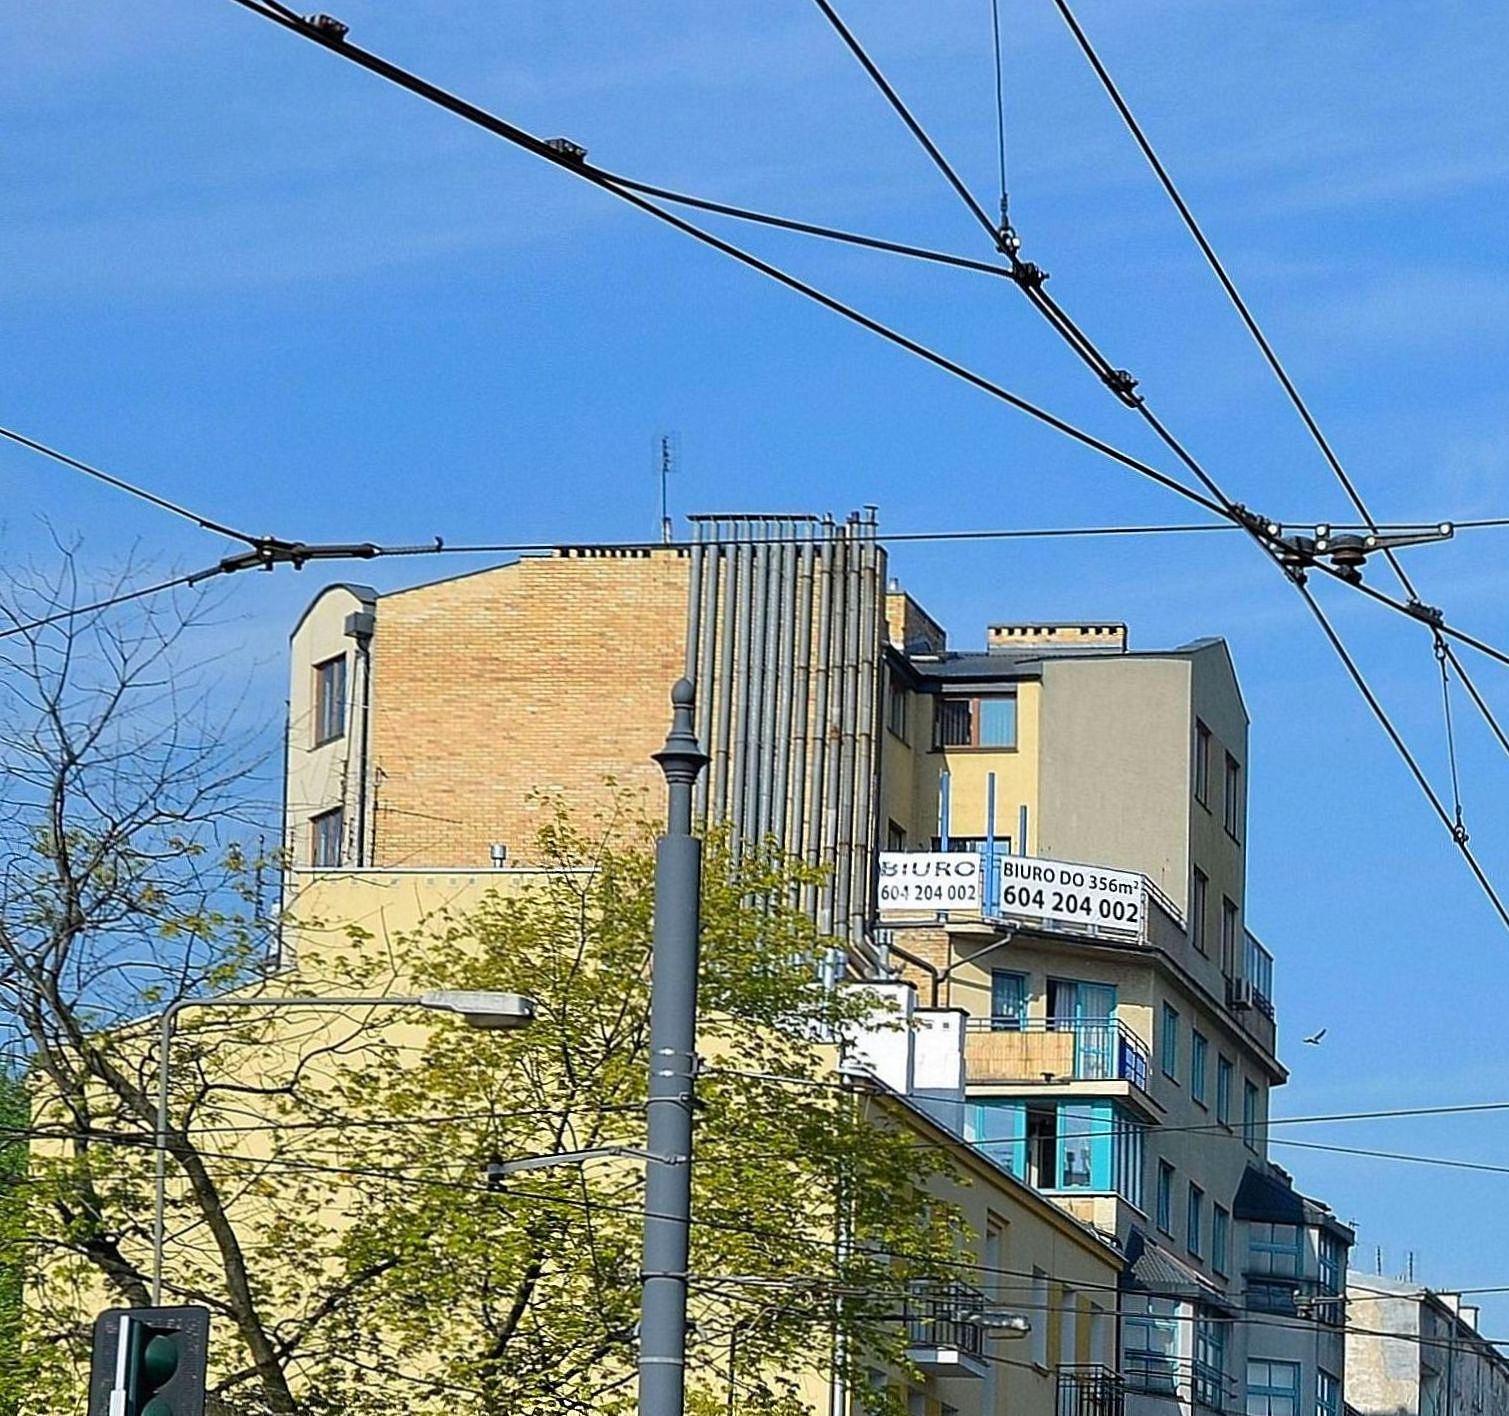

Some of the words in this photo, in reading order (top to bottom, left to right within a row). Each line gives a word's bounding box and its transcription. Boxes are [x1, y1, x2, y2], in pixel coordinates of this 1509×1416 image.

[880, 861, 976, 877] BIURO
[1004, 862, 1055, 883] BIURO
[1060, 870, 1085, 888] DO
[881, 885, 909, 901] 604
[915, 885, 943, 901] 204
[948, 885, 976, 901] 002
[1003, 885, 1045, 910] 604
[1052, 892, 1093, 917] 204
[1099, 899, 1139, 924] 002
